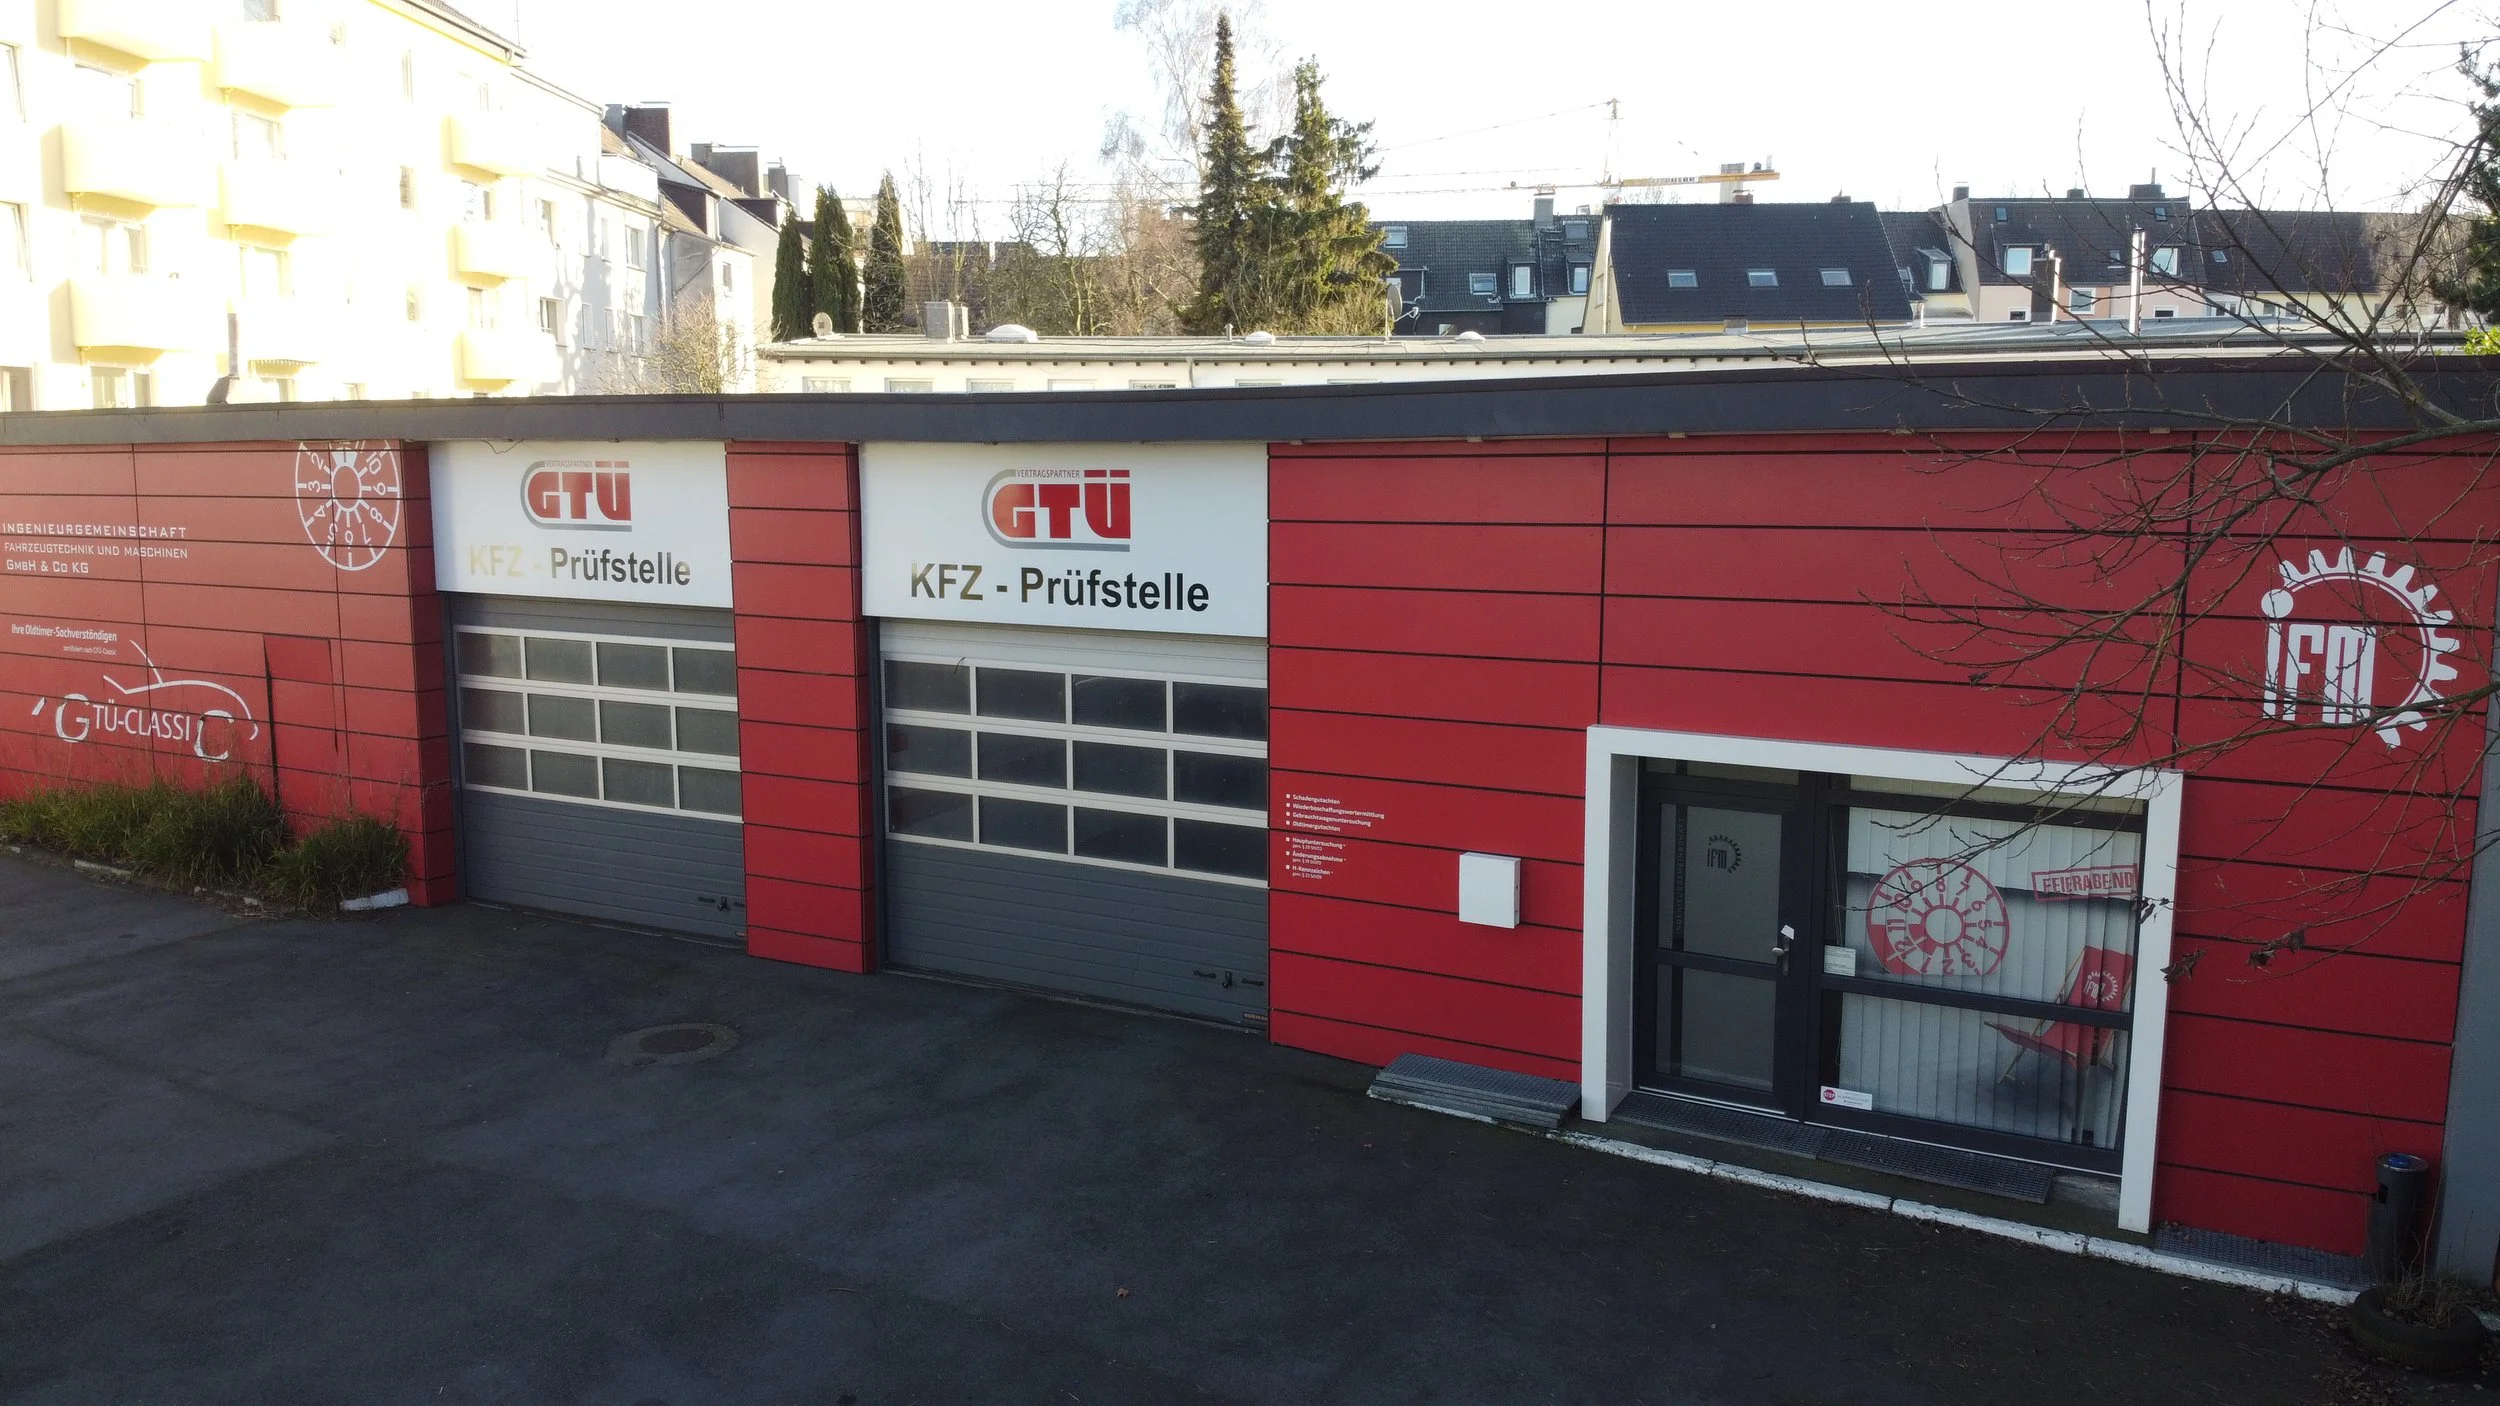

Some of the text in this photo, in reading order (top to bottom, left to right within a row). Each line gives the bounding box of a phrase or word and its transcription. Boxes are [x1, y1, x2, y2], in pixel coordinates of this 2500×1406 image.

[311, 452, 324, 470] 2
[1016, 469, 1080, 479] VERTRAGSPARTNER
[308, 480, 320, 493] 3
[527, 461, 632, 521] GTÜ
[313, 504, 326, 517] 4
[992, 469, 1132, 540] GTÜ
[370, 507, 383, 523] 8
[3, 523, 187, 539] INGENIEURGEMEINSCHAFT
[4, 542, 188, 559] FAHRZEUGTECHNIK UND MASCHINEN
[41, 561, 49, 572] &
[72, 562, 89, 574] KG
[469, 544, 525, 577] KFZ
[550, 547, 691, 586] Prüfstelle
[911, 562, 984, 601] KFZ
[1020, 566, 1210, 612] Prüfstelle
[12, 624, 25, 635] Ihre
[55, 693, 234, 762] GTÜ-CLASSIC
[2043, 872, 2132, 893] FEIERABEND
